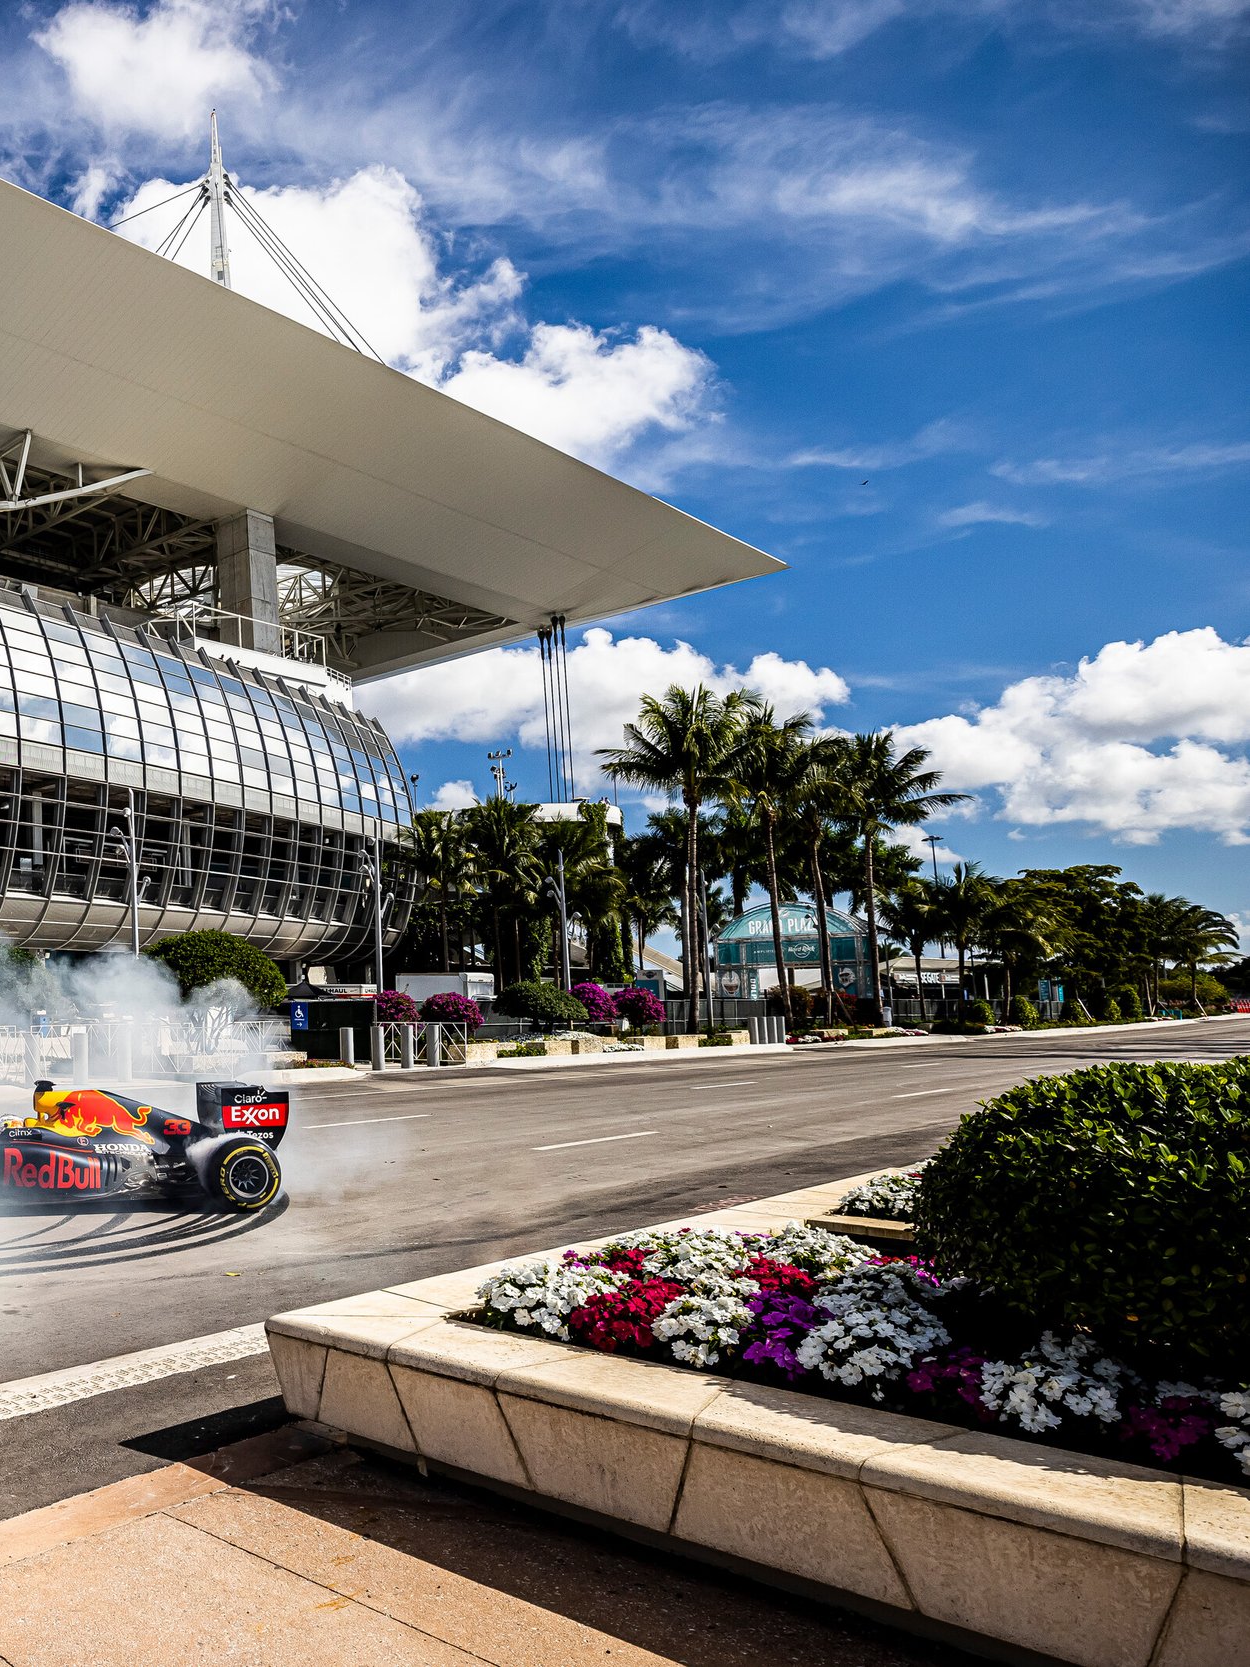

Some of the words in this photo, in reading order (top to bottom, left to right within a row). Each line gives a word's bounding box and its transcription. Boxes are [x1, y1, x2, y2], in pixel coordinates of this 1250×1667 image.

[234, 1093, 263, 1103] Claro
[231, 1106, 280, 1126] Exxon
[163, 1118, 191, 1136] 33
[93, 1143, 151, 1153] HONDA
